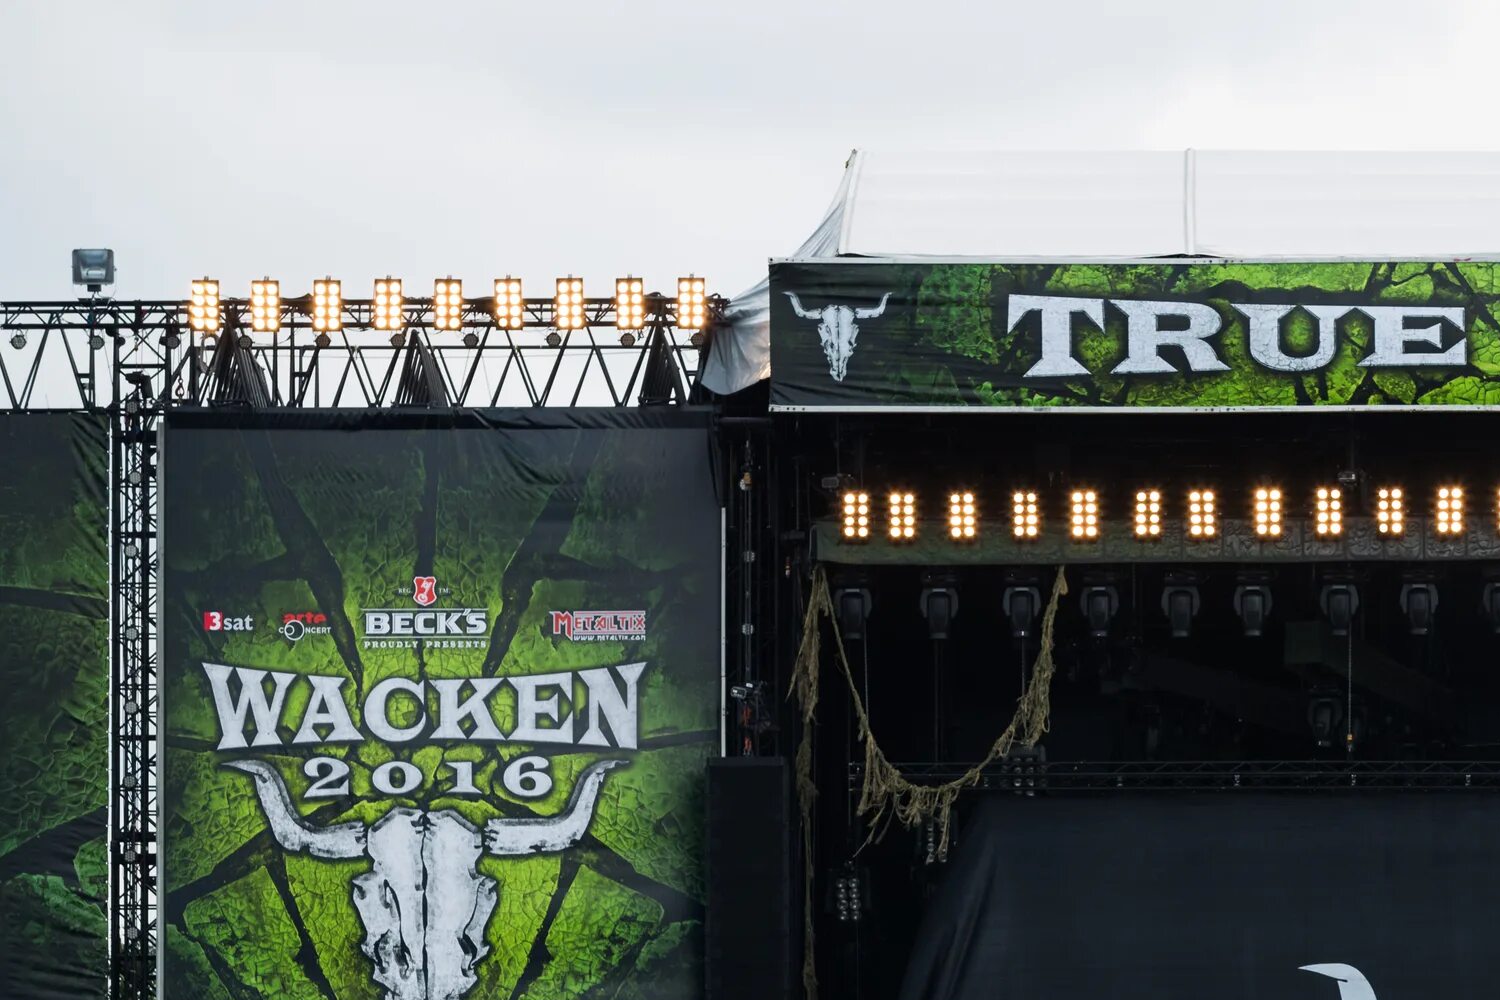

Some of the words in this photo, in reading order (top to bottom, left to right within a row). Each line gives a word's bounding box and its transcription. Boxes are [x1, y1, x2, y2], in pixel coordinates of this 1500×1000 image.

[1007, 293, 1468, 378] TRUE
[209, 611, 254, 631] 3sat
[282, 611, 327, 624] arte
[365, 608, 487, 635] BECK'S
[549, 611, 646, 641] METALTIX
[364, 640, 418, 649] PROUDLY
[426, 640, 487, 648] PRESENTS
[202, 661, 648, 750] WACKEN
[303, 756, 552, 798] 2016
